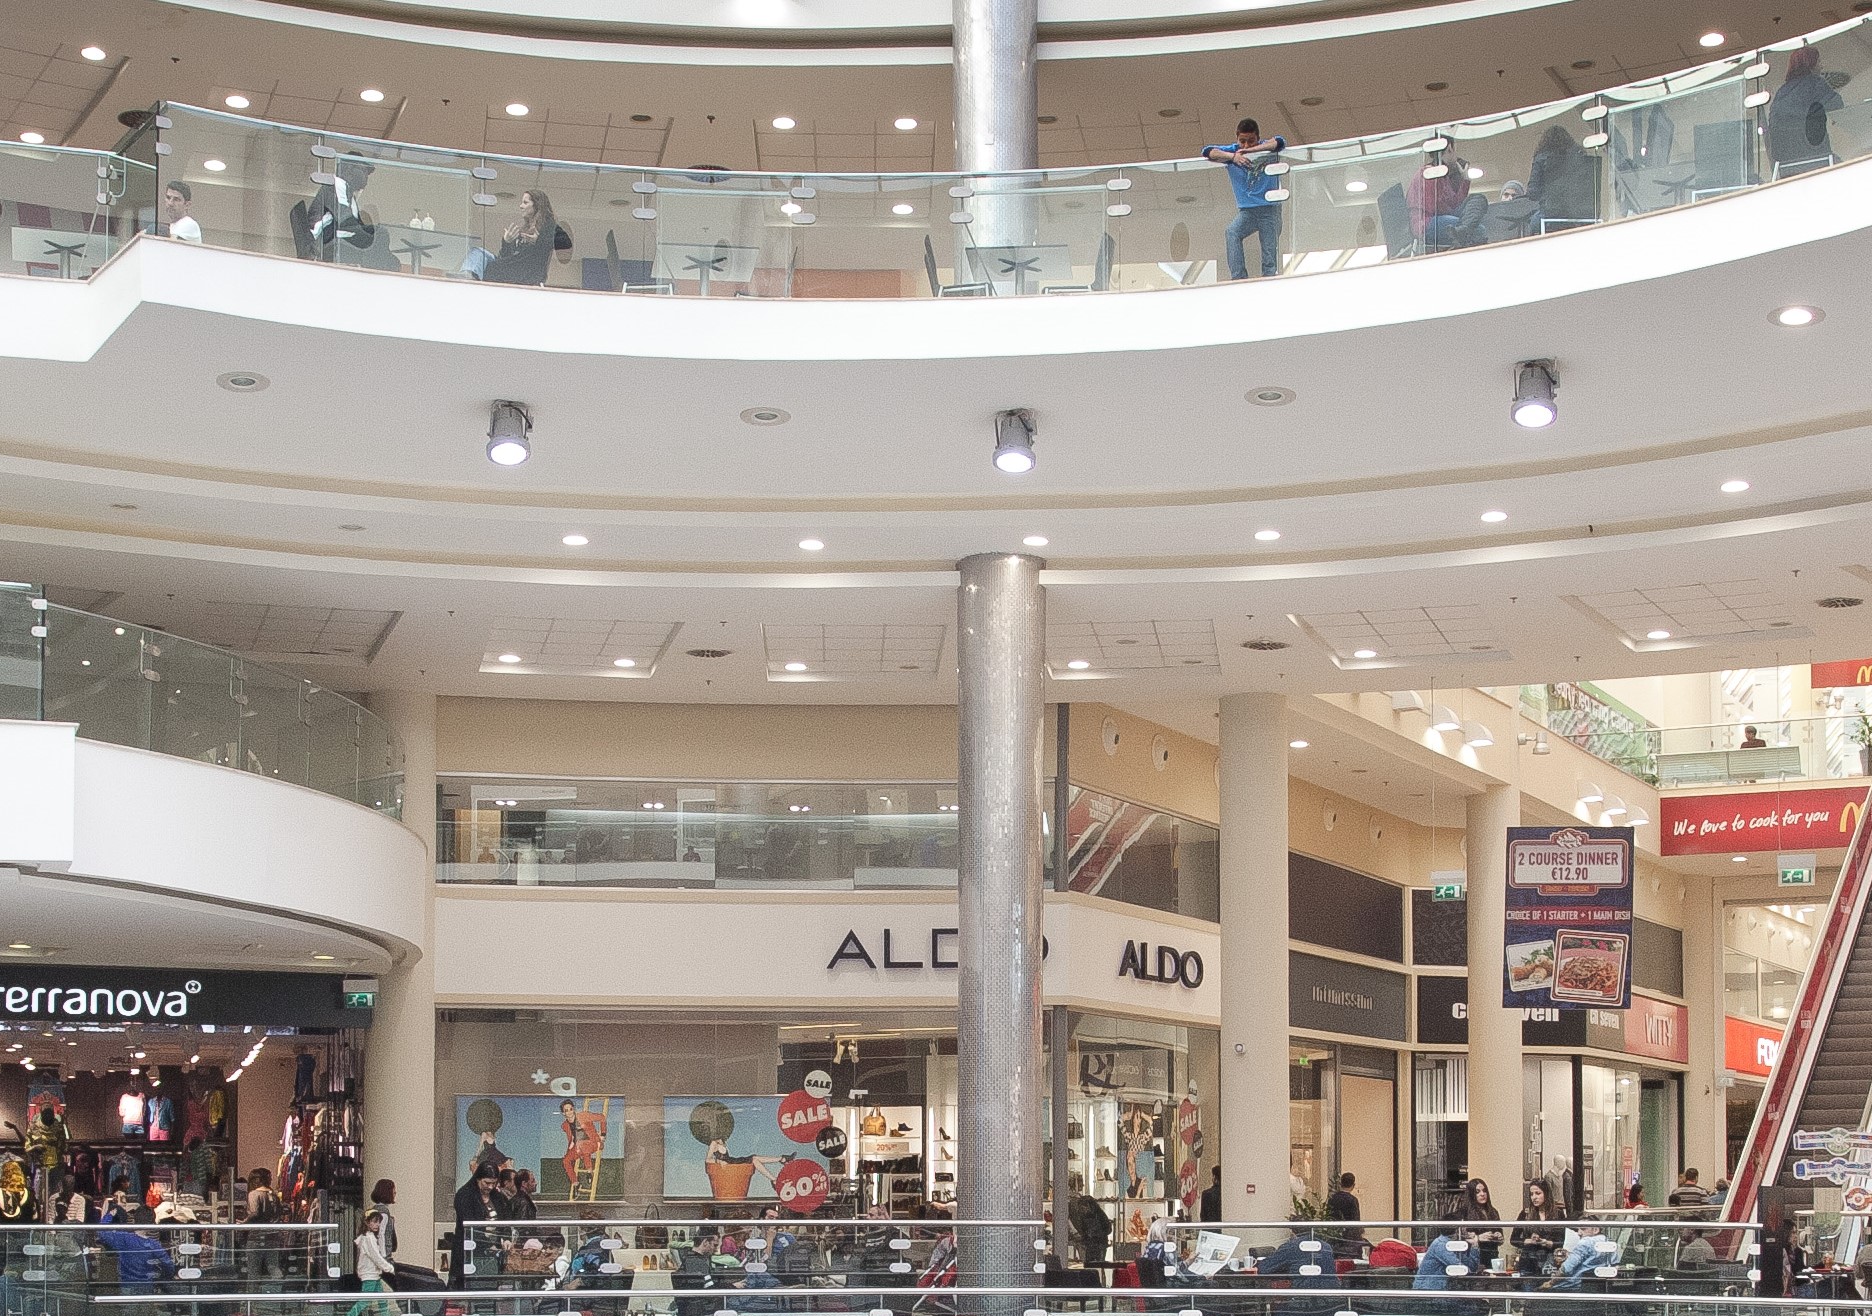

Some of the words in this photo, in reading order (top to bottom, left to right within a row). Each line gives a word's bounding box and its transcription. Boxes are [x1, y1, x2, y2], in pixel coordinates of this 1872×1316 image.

[1674, 818, 1697, 836] We
[1699, 813, 1727, 834] love
[1731, 814, 1746, 831] to
[1748, 812, 1779, 829] cook
[1781, 807, 1803, 828] for
[1804, 810, 1829, 830] you
[1518, 853, 1525, 865] 2
[1529, 852, 1573, 865] COURSE
[1578, 852, 1619, 865] DINNER
[1551, 867, 1588, 881] €12.90
[1506, 910, 1531, 920] CHOICE
[1548, 910, 1578, 920] STARTER
[1593, 910, 1613, 920] MAIN
[828, 928, 1048, 970] ALD
[1119, 939, 1204, 989] ALDO
[806, 1079, 832, 1089] SALE
[781, 1104, 828, 1130] SALE
[1180, 1110, 1197, 1132] SALE
[818, 1133, 847, 1151] SALE
